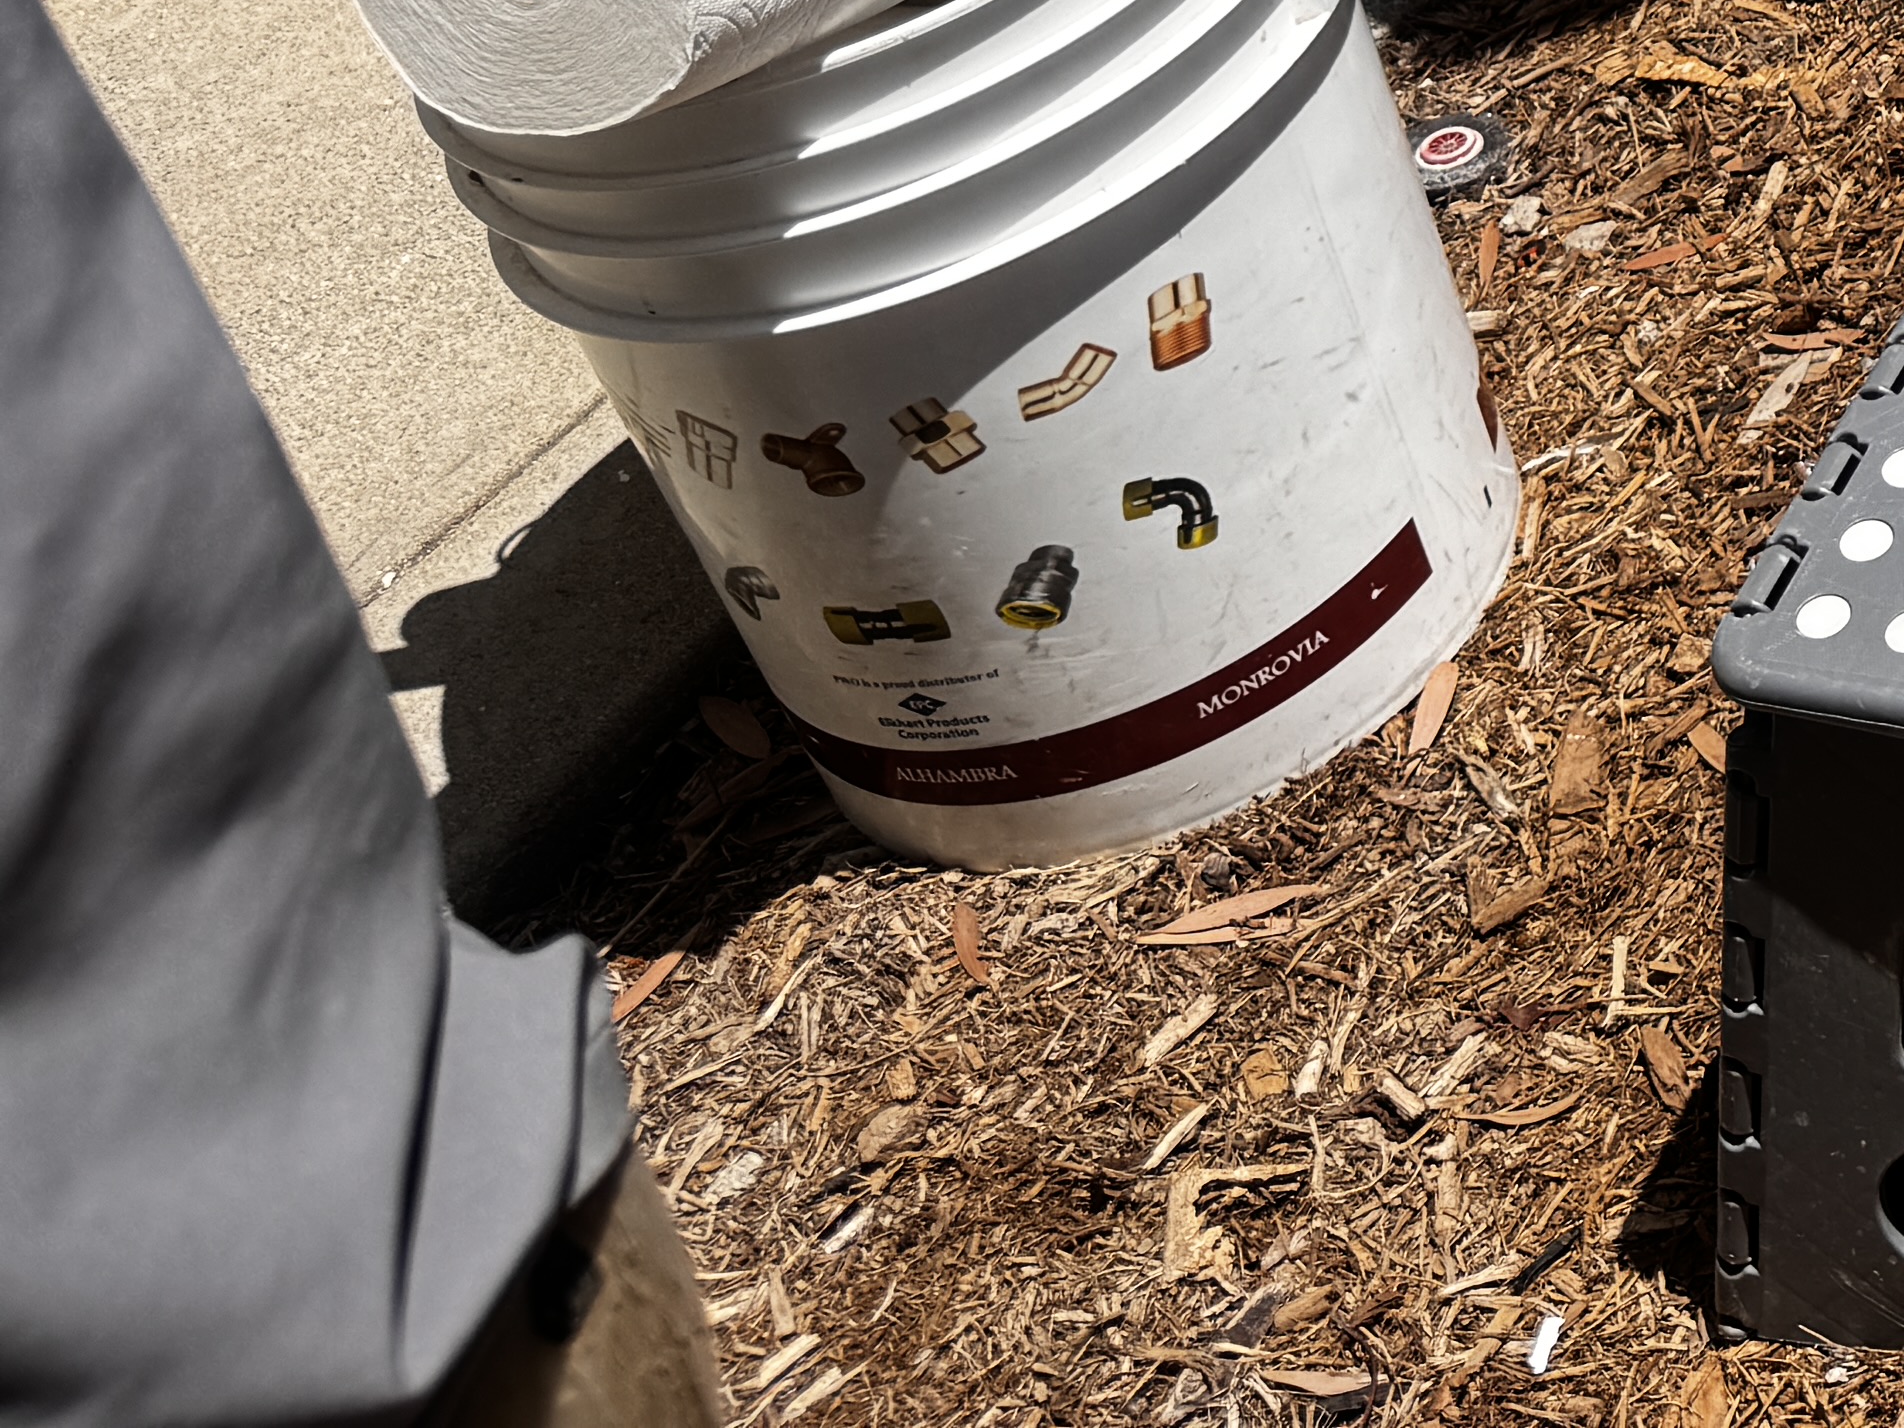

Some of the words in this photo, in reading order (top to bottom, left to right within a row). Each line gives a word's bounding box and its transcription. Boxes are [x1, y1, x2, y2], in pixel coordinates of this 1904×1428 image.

[917, 673, 984, 688] distributor
[986, 668, 999, 679] of
[1196, 629, 1331, 719] MONROVIA
[926, 714, 990, 728] Products
[897, 727, 980, 741] Corporation
[896, 764, 1018, 784] ALHAMBRA
